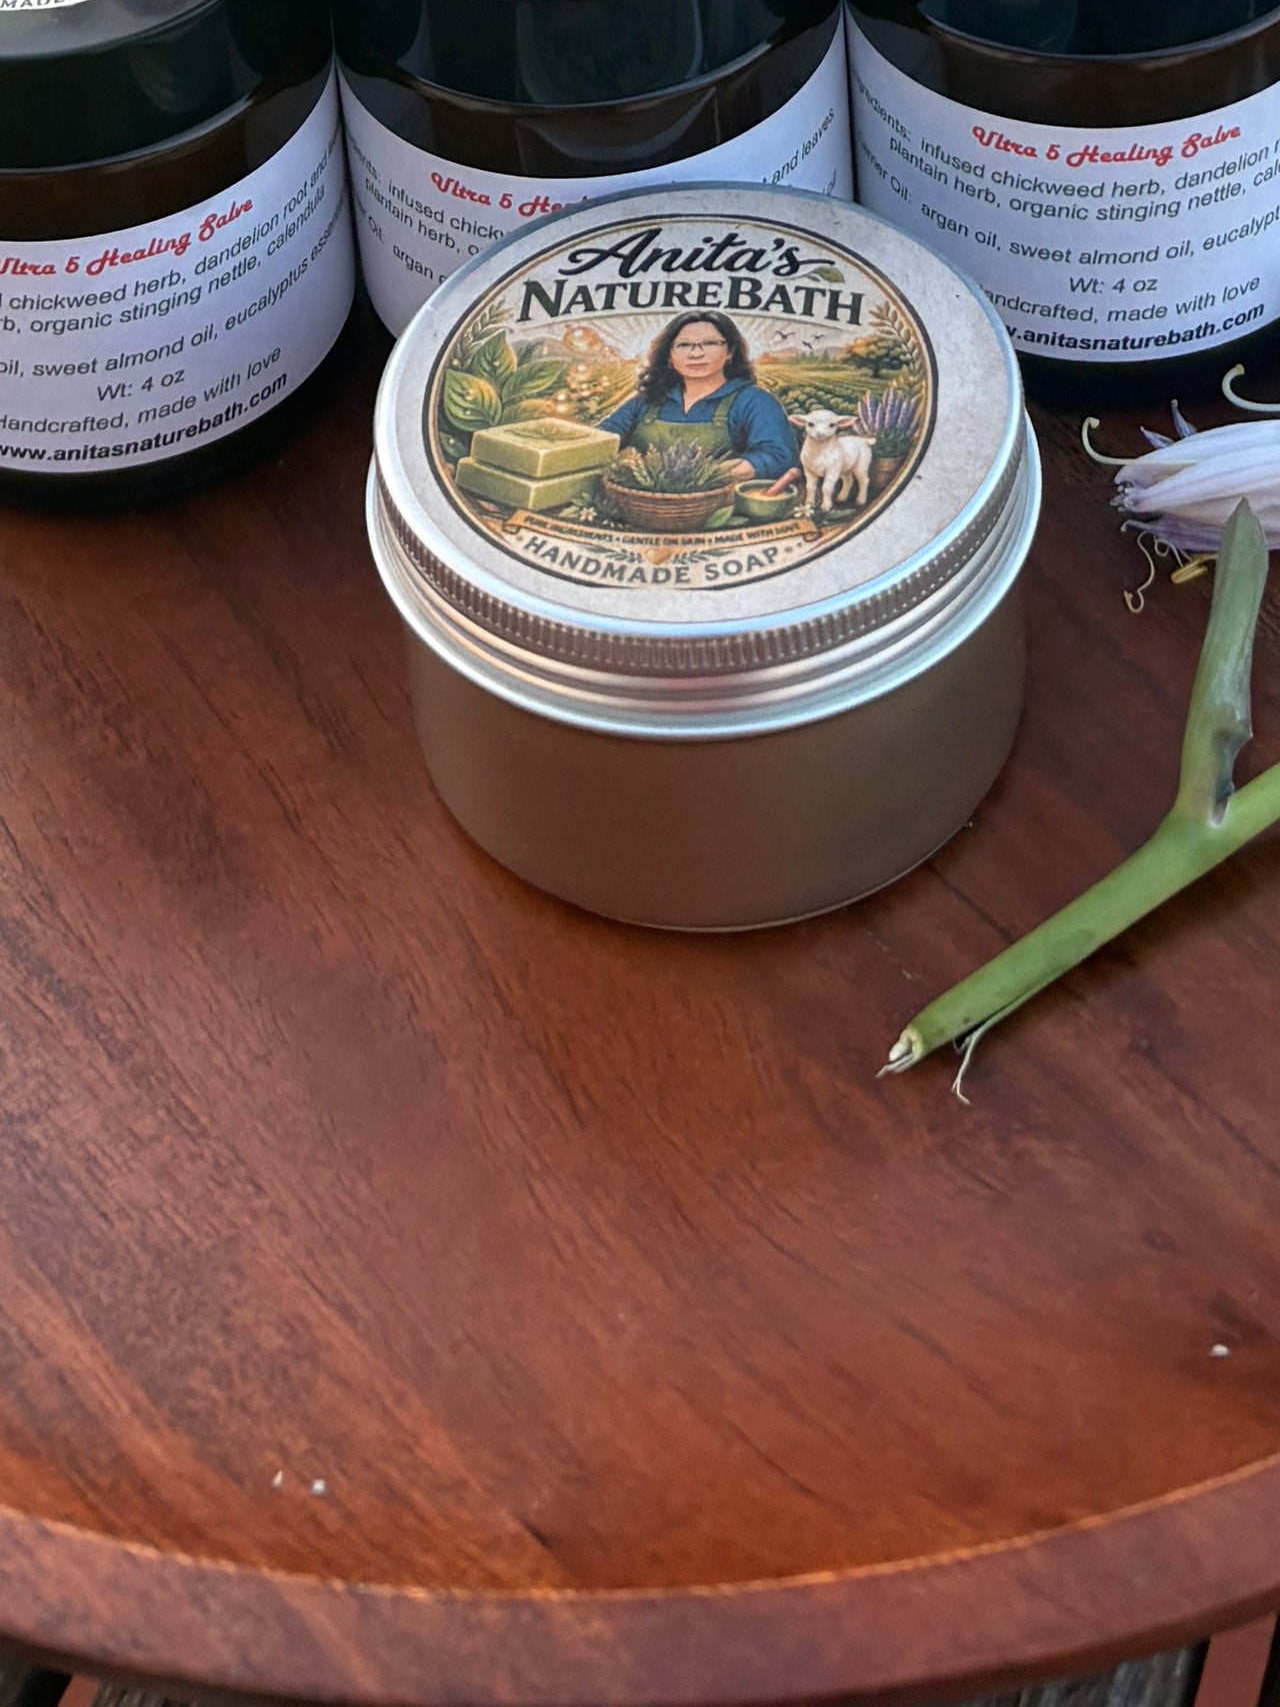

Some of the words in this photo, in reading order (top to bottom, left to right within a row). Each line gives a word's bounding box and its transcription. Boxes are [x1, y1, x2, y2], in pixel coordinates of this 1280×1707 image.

[772, 150, 799, 185] and
[801, 108, 835, 160] leaves
[921, 137, 985, 178] infused
[992, 168, 1104, 199] chickweed
[1112, 178, 1166, 197] herb,
[1174, 147, 1270, 191] dandelion
[972, 126, 1037, 158] Ultra
[1046, 144, 1060, 161] 5
[1066, 143, 1173, 168] Healing
[1181, 124, 1241, 158] Salve
[388, 180, 445, 223] infused
[450, 215, 506, 240] chick
[430, 172, 491, 206] Ultra
[499, 194, 513, 209] 5
[890, 137, 948, 185] plantain
[954, 176, 1001, 208] herb,
[1009, 196, 1088, 220] organic
[1096, 197, 1180, 222] stinging
[1188, 181, 1247, 211] nettle,
[9, 278, 126, 311] chickweed
[134, 269, 186, 297] herb,
[195, 212, 278, 276] dandelion
[284, 180, 307, 219] root
[65, 257, 79, 273] 5
[86, 232, 191, 276] Healing
[198, 197, 253, 242] Salve
[365, 178, 413, 228] plantain
[418, 221, 460, 253] herb,
[921, 202, 969, 238] argan
[975, 229, 1001, 252] oil,
[1009, 240, 1072, 263] sweet
[1078, 245, 1158, 265] almond
[1166, 241, 1195, 260] oil,
[30, 310, 112, 335] organic
[120, 286, 201, 323] stinging
[208, 256, 261, 295] nettle,
[267, 185, 325, 256] calendula
[393, 245, 433, 278] argan
[558, 227, 835, 279] Anita's
[980, 284, 1098, 323] andcrafted,
[1108, 304, 1167, 323] made
[1175, 292, 1216, 315] with
[1222, 276, 1261, 304] love
[1070, 277, 1104, 294] Wt:
[1112, 279, 1125, 293] 4
[1133, 278, 1158, 292] oz
[32, 357, 98, 377] sweet
[105, 334, 184, 372] almond
[191, 323, 218, 347] oil,
[225, 259, 308, 331] eucalyptus
[1006, 303, 1264, 350] w.anitasnaturebath.com
[96, 383, 132, 401] Wt:
[140, 377, 154, 393] 4
[161, 370, 185, 386] oz
[138, 396, 196, 423] made
[204, 373, 241, 403] with
[247, 346, 281, 378] love
[524, 536, 691, 584] HANDMADE
[705, 546, 779, 581] SOAP
